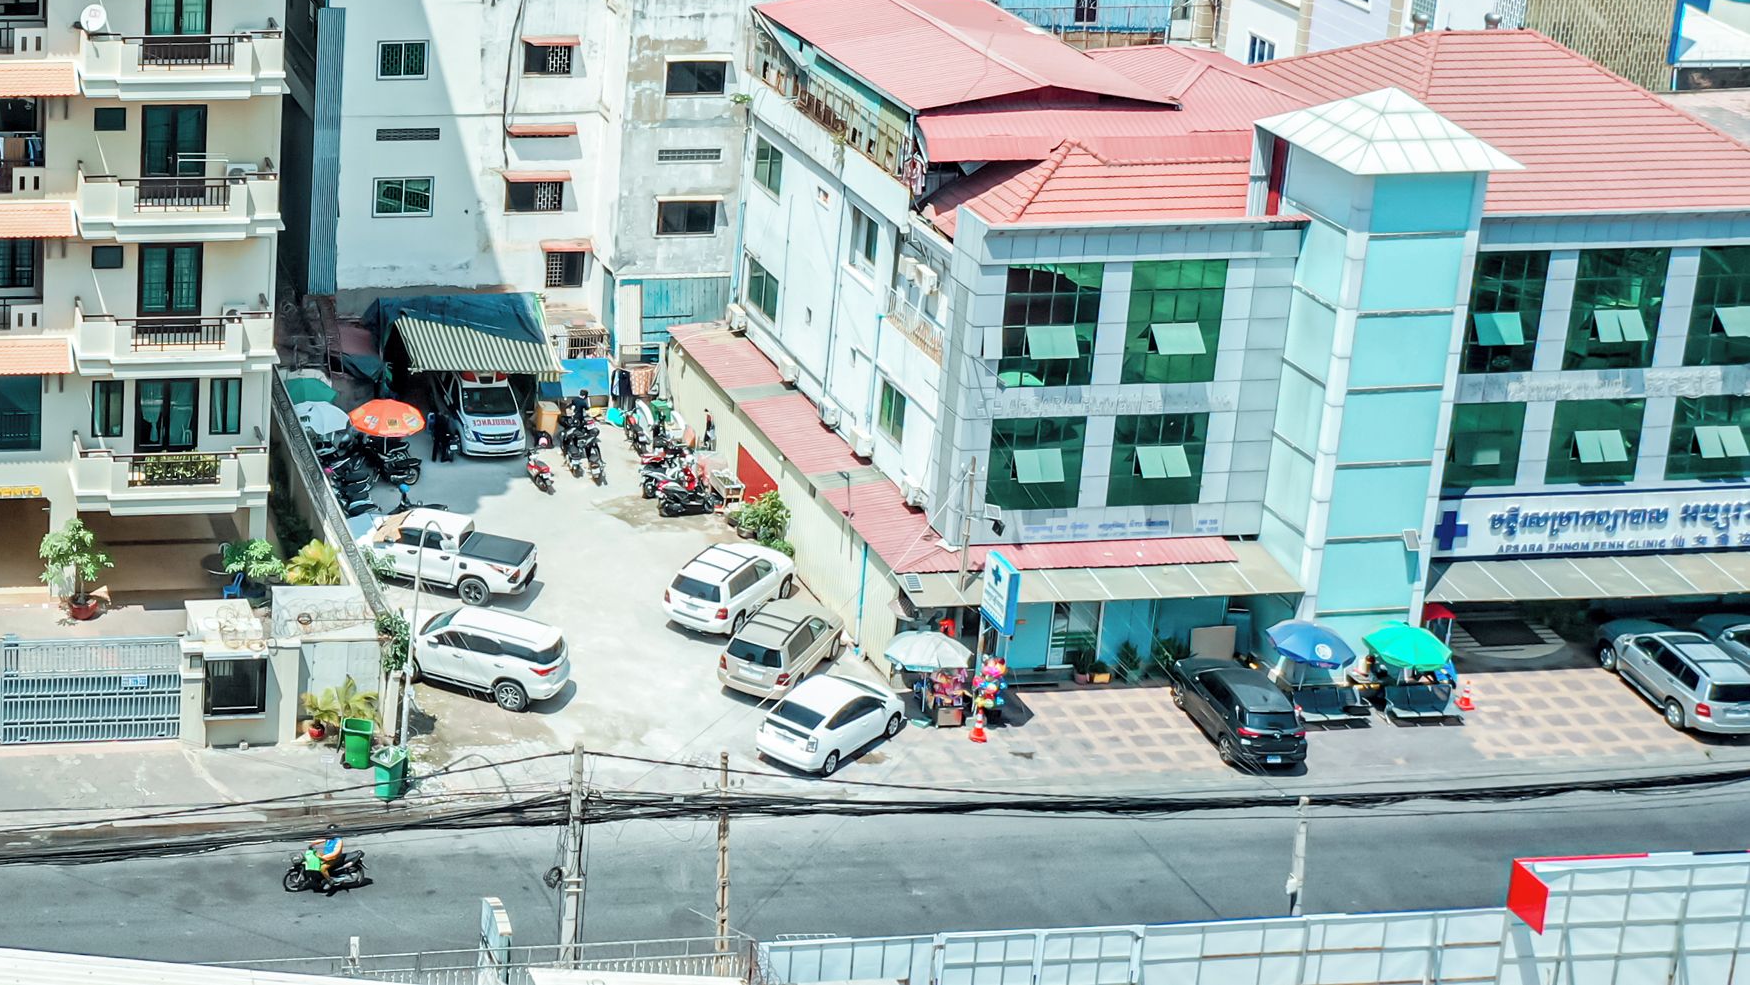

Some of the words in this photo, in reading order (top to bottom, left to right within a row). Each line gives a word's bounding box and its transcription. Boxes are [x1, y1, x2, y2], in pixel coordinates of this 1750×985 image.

[1497, 543, 1544, 553] APSARA
[1548, 542, 1590, 552] PHNOM
[1592, 541, 1625, 550] PENH
[1627, 538, 1667, 549] CLINIC
